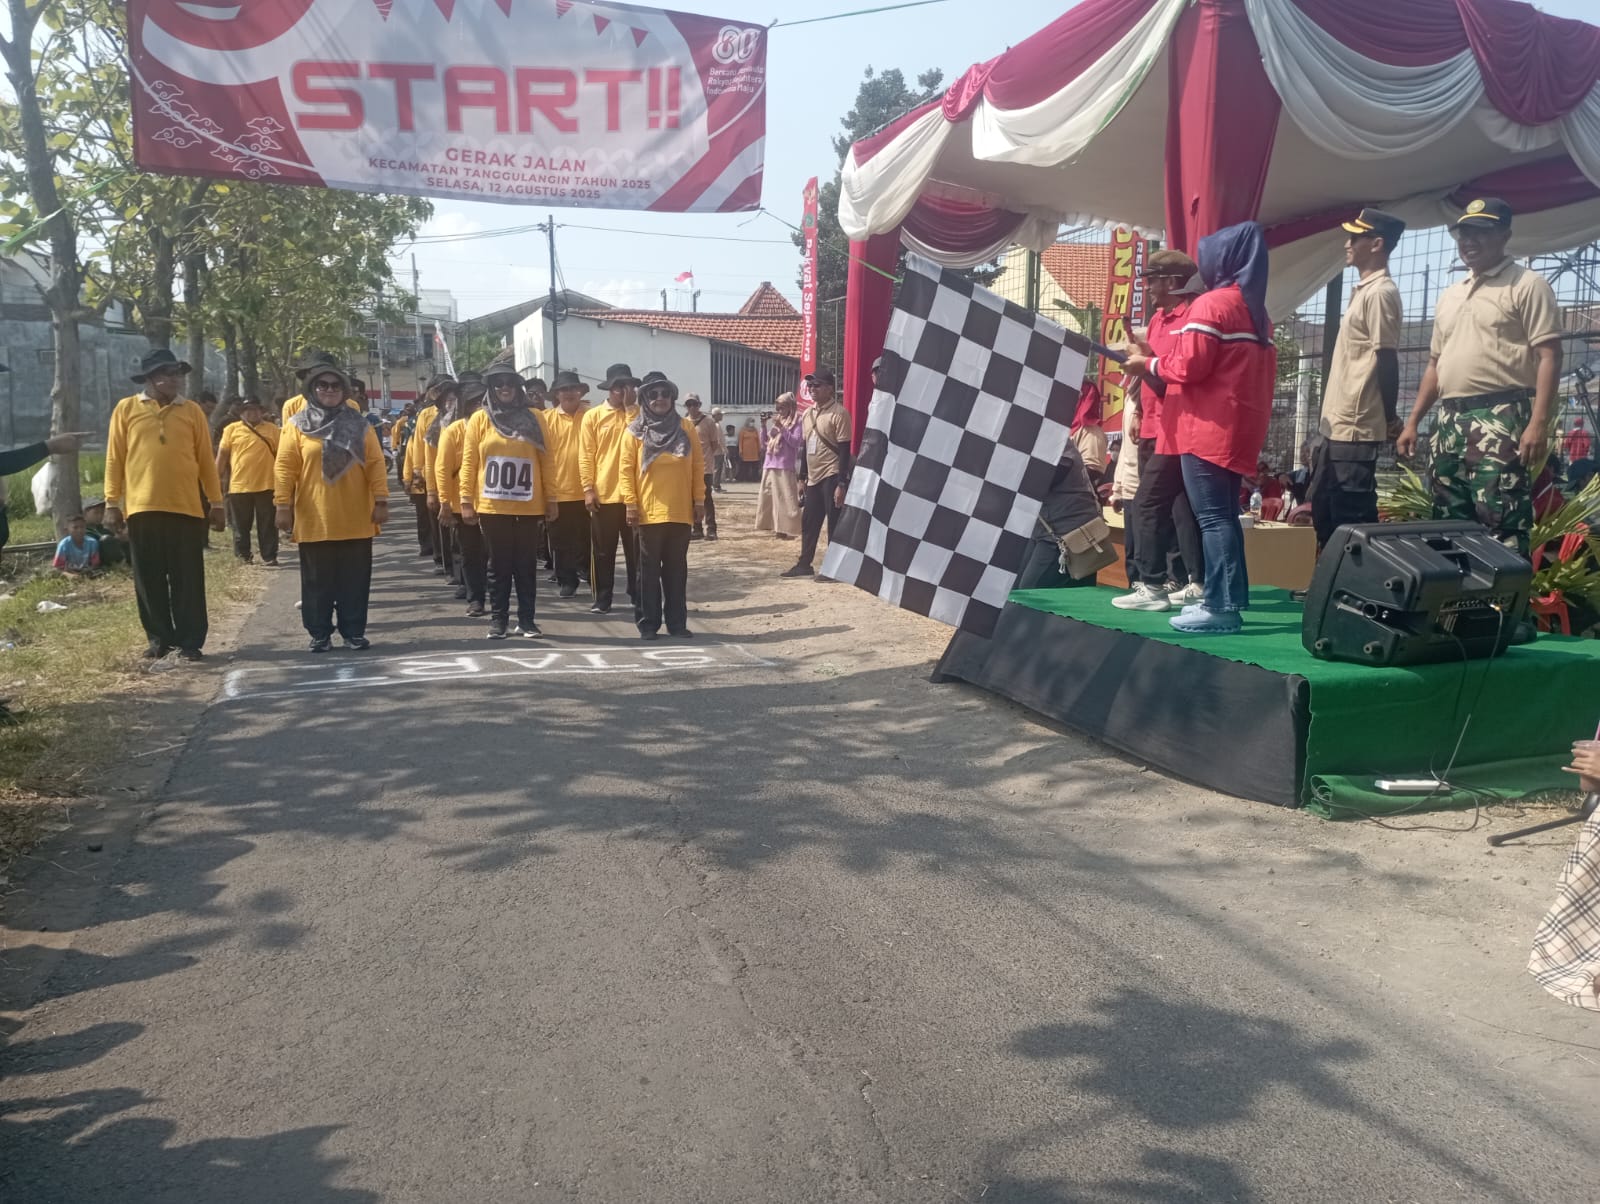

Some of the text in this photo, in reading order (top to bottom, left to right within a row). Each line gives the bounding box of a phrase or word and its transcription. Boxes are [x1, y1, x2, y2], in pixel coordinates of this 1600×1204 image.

[291, 60, 682, 135] START!!
[369, 157, 651, 190] KECAMATAN TANGGULANGIN TAHUN 2025
[446, 147, 586, 172] GERAK JALAN
[427, 177, 601, 199] SELASA, 12 AGUSTUS 2025
[1130, 241, 1144, 324] REPUBLI
[803, 292, 813, 362] Sejahtera
[485, 460, 532, 491] 004
